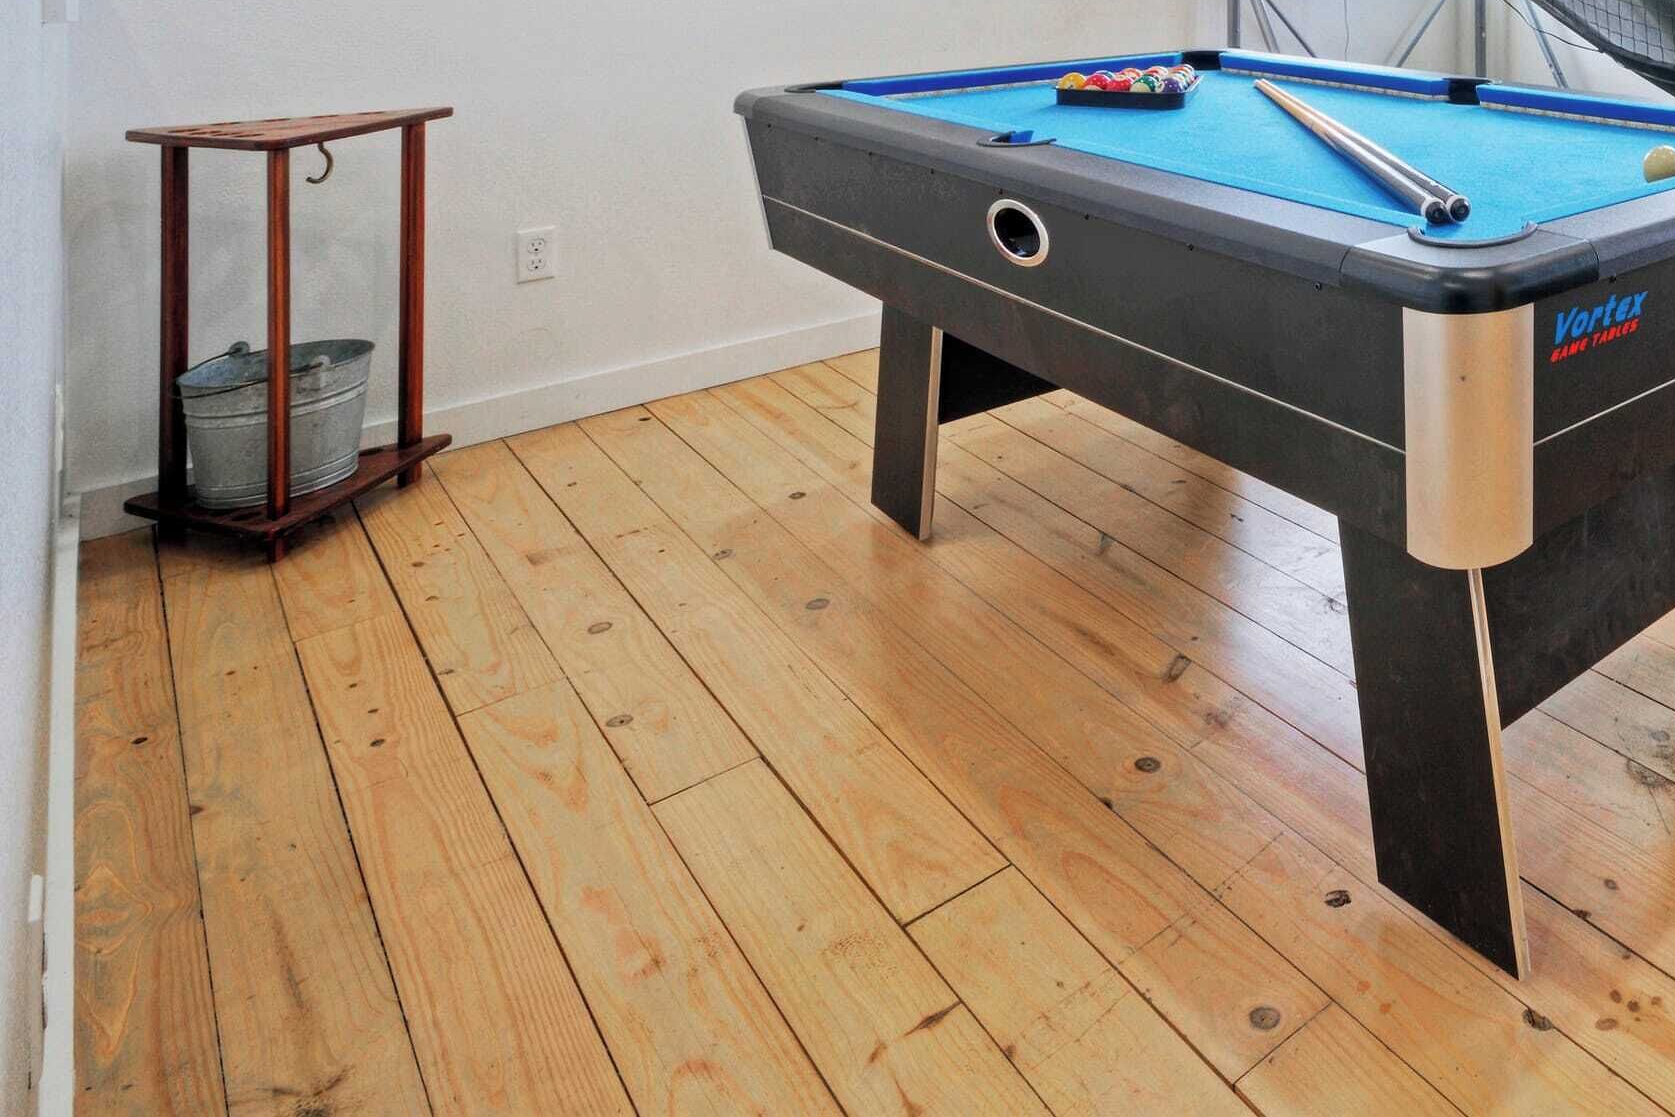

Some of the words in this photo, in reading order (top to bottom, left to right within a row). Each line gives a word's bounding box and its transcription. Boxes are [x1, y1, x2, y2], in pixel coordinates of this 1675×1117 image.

[1550, 338, 1589, 364] GAME
[1592, 318, 1640, 347] TABLES
[1553, 290, 1648, 345] Vortex
